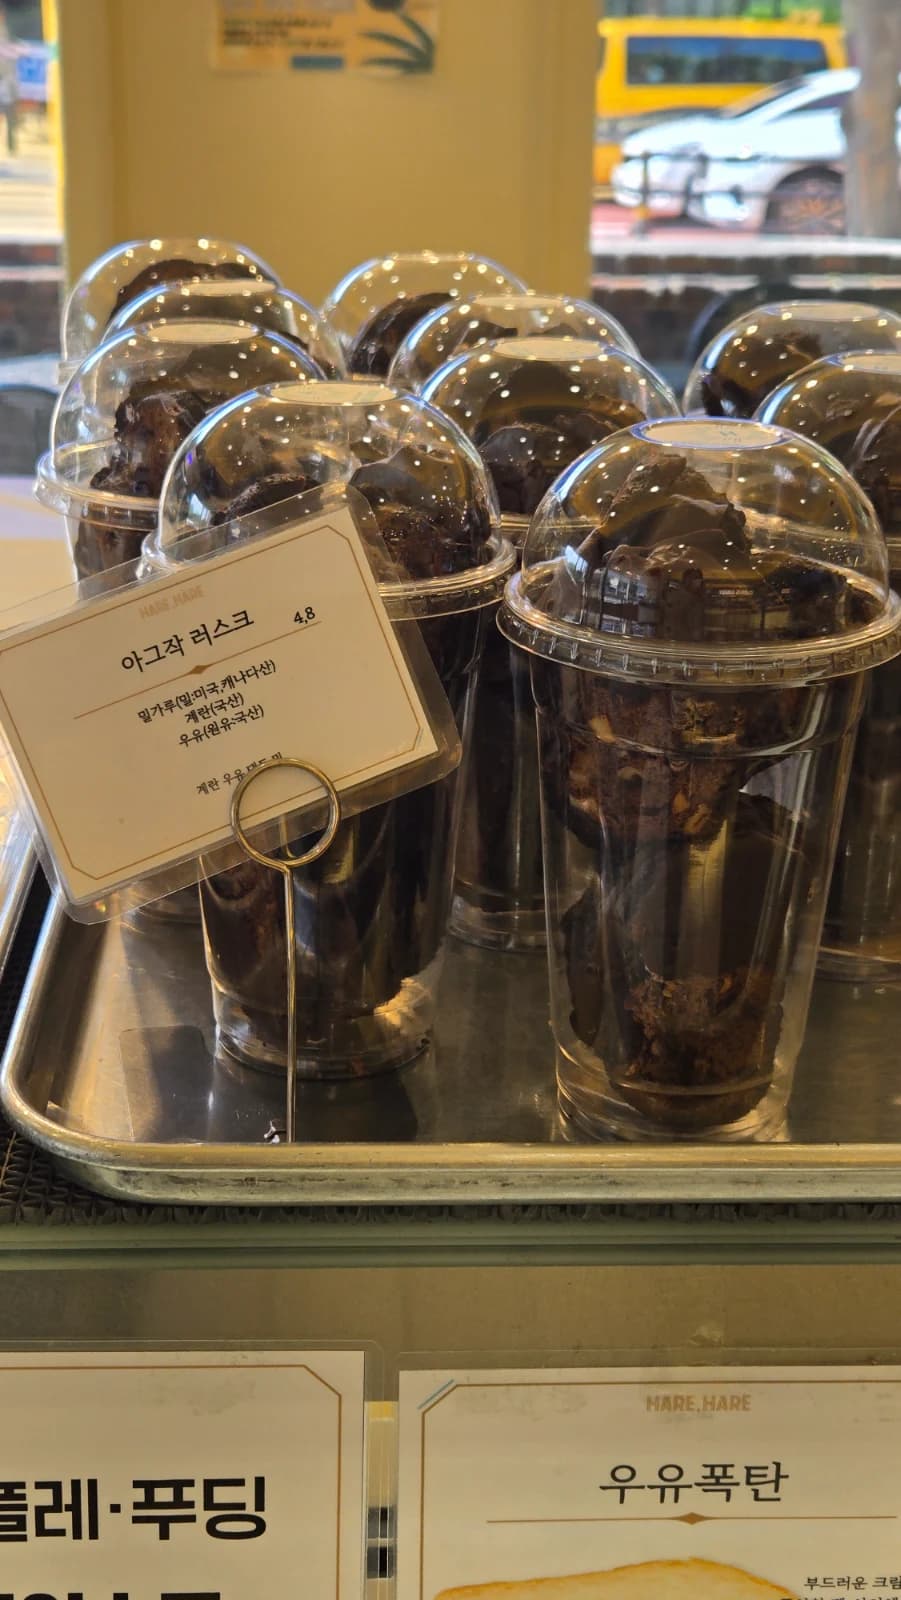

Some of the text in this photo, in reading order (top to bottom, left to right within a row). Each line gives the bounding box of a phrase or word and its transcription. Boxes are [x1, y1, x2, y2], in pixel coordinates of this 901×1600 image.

[293, 606, 316, 625] 4,8
[121, 609, 255, 673] 아그작 러스크
[185, 692, 245, 724] 계란(국산)
[179, 704, 265, 747] 우유(원유:국산)
[195, 777, 221, 795] 계란
[599, 1460, 790, 1505] 우유폭탄
[803, 1576, 868, 1591] 부드러운
